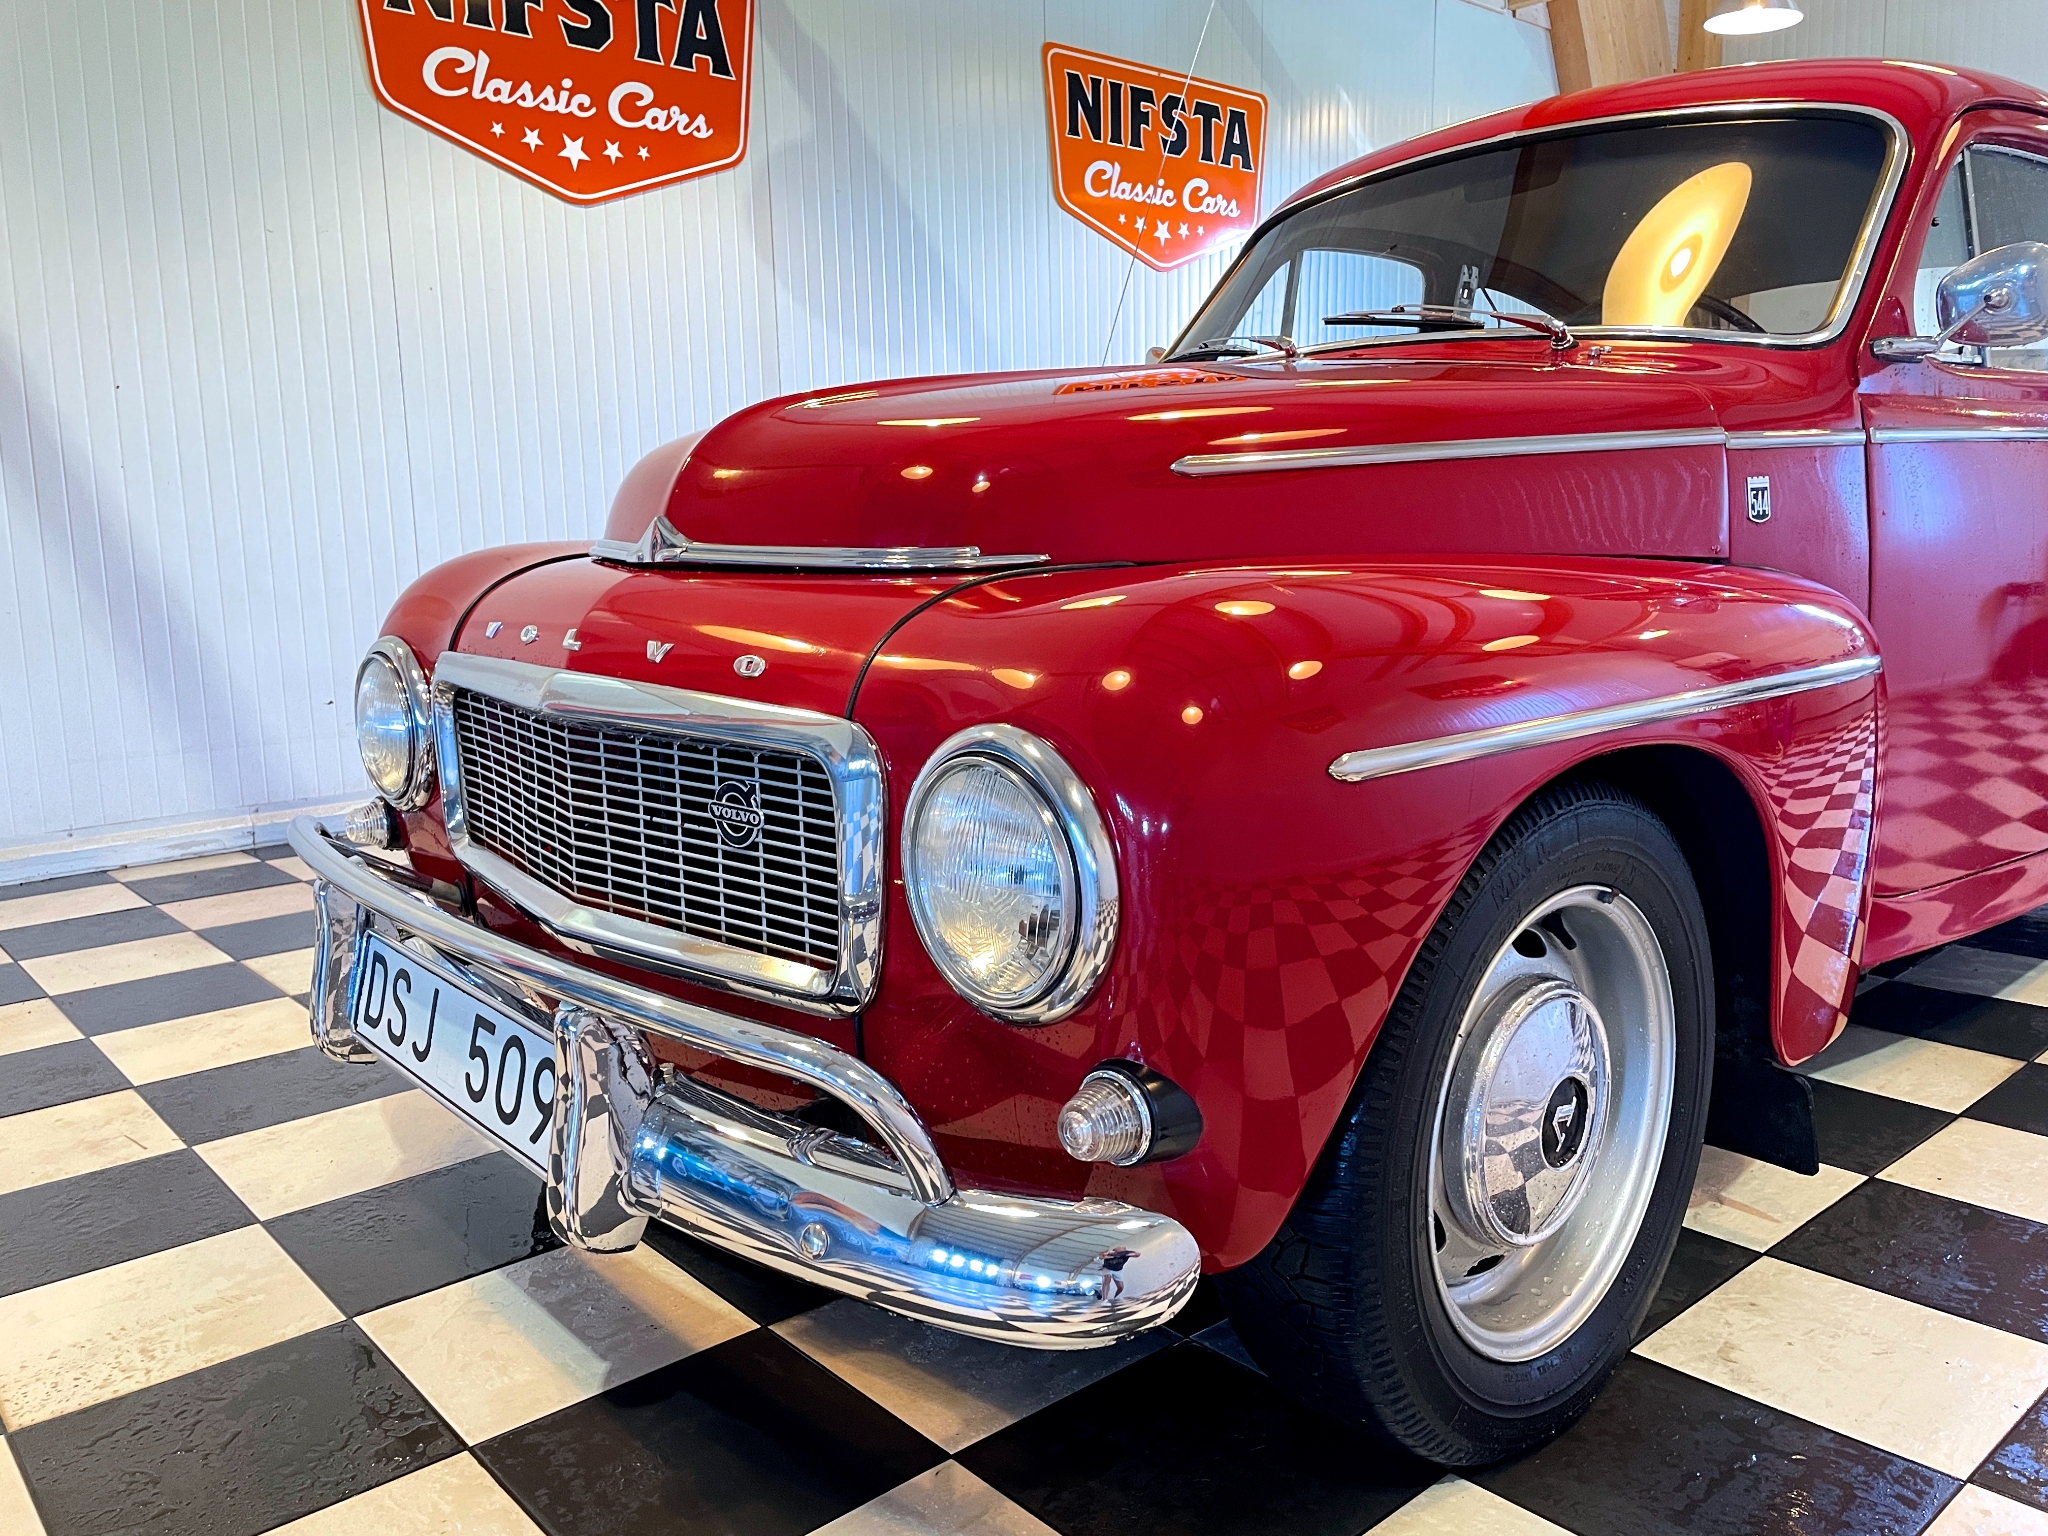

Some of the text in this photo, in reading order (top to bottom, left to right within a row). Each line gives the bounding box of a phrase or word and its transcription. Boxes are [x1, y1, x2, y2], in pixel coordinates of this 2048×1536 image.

[383, 0, 737, 80] STA
[422, 46, 713, 139] Classic Cars
[1063, 68, 1255, 172] NIFSTA
[1084, 160, 1240, 218] Classic Cars
[1751, 490, 1769, 515] 544
[485, 621, 767, 678] VOLVO
[710, 803, 761, 826] VOLVO
[363, 950, 556, 1144] DSJ 509
